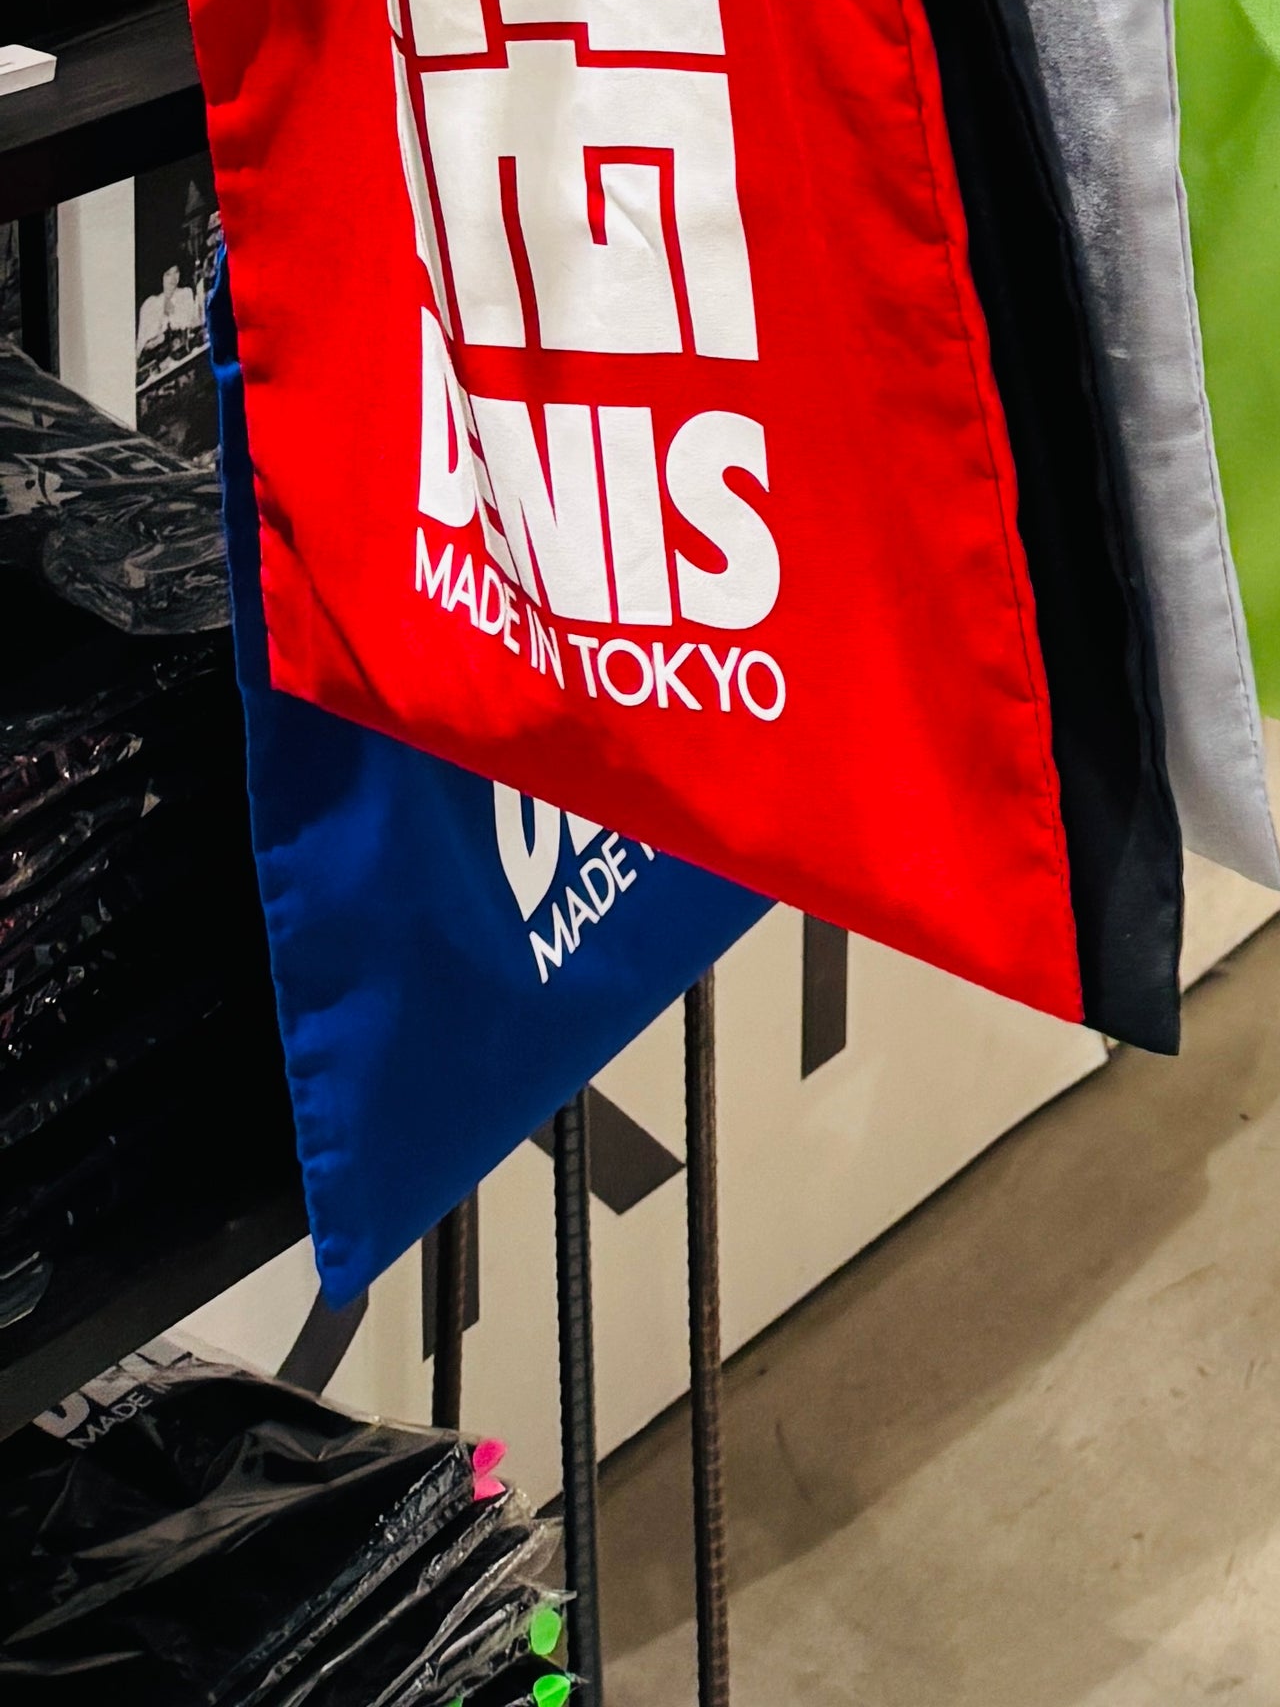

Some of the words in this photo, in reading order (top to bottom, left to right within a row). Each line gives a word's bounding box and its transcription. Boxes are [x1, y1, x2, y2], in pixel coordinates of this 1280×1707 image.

[415, 527, 521, 655] MADE
[526, 603, 565, 690] IN
[567, 634, 787, 722] TOKYO
[529, 831, 638, 984] MADE
[67, 1390, 154, 1450] MADE
